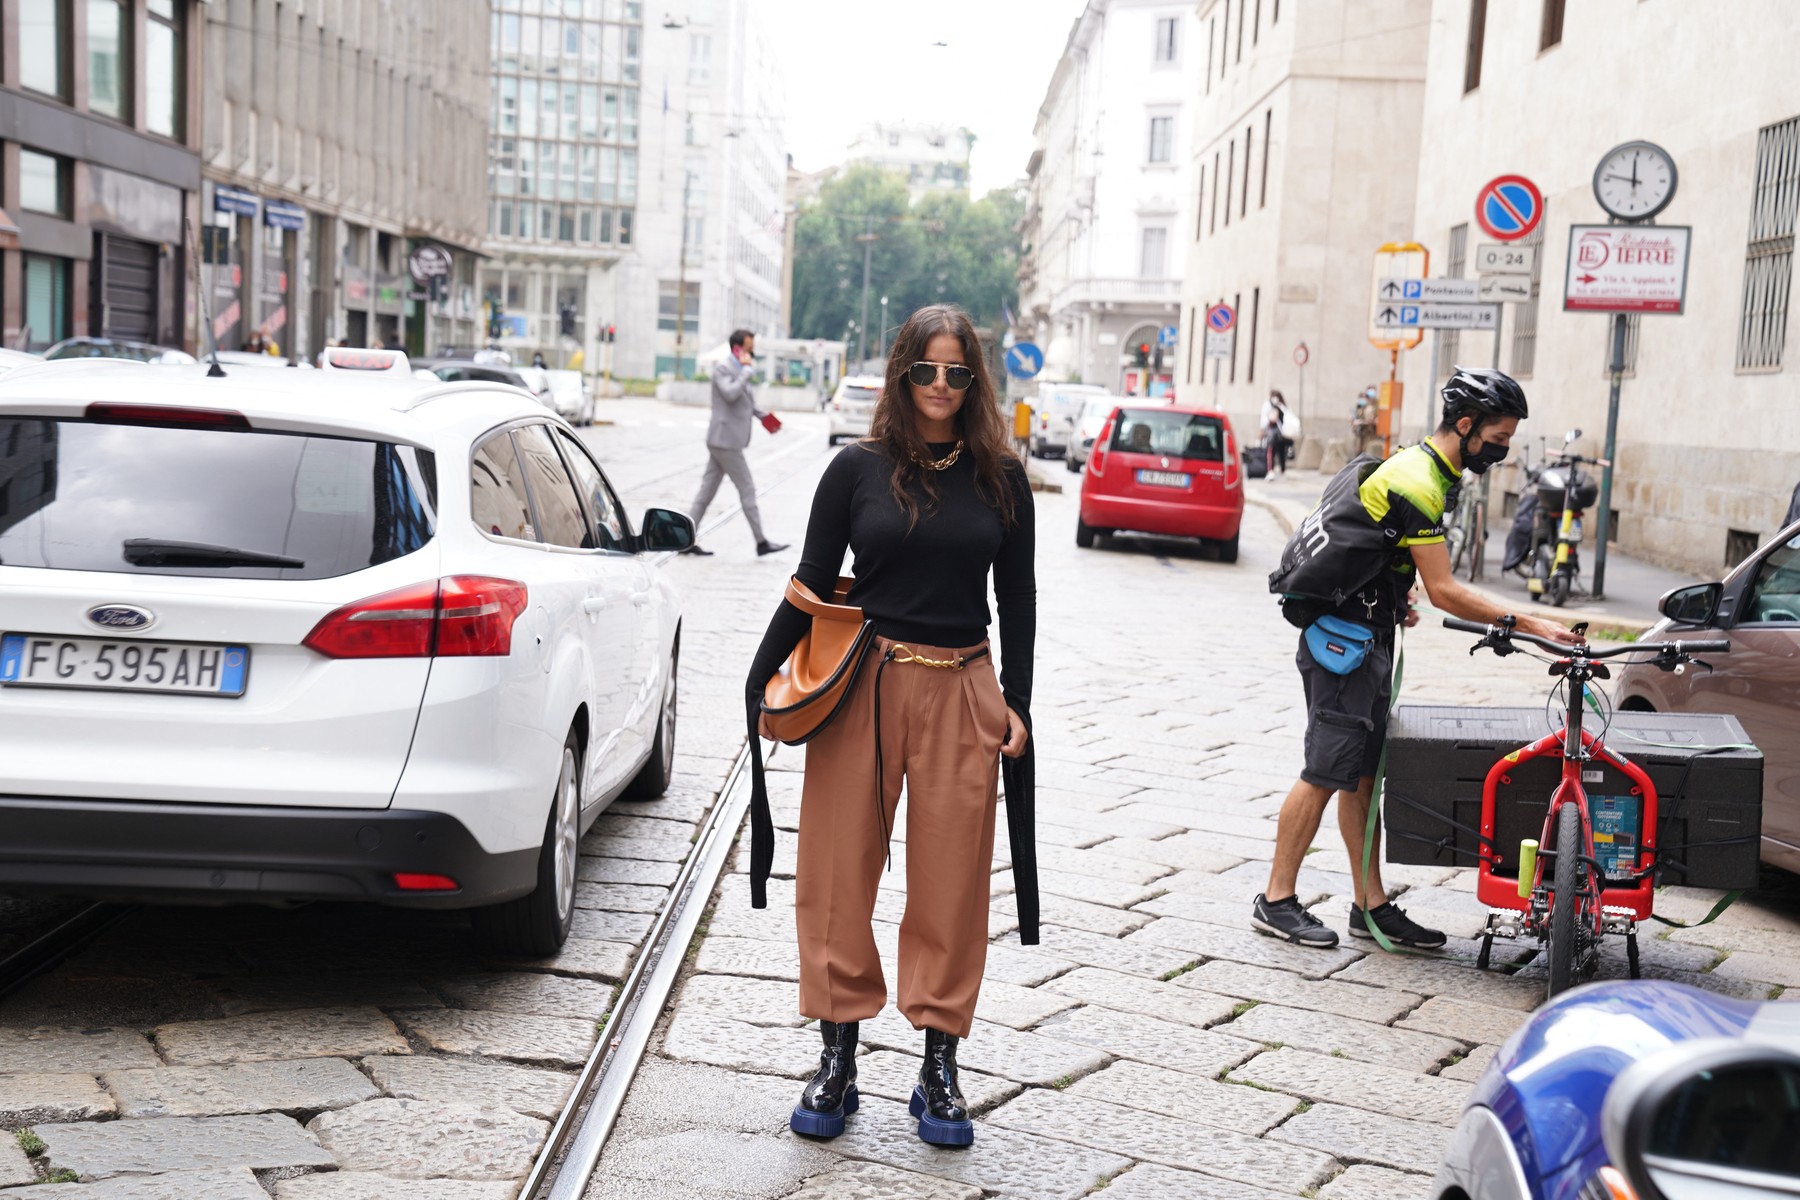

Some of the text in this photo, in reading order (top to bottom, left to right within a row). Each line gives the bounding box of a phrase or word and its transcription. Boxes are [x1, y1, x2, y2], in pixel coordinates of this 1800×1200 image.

[1616, 247, 1676, 265] TERRE
[331, 352, 393, 370] TAXI
[101, 609, 141, 626] Ford
[27, 640, 221, 687] FG 595AH
